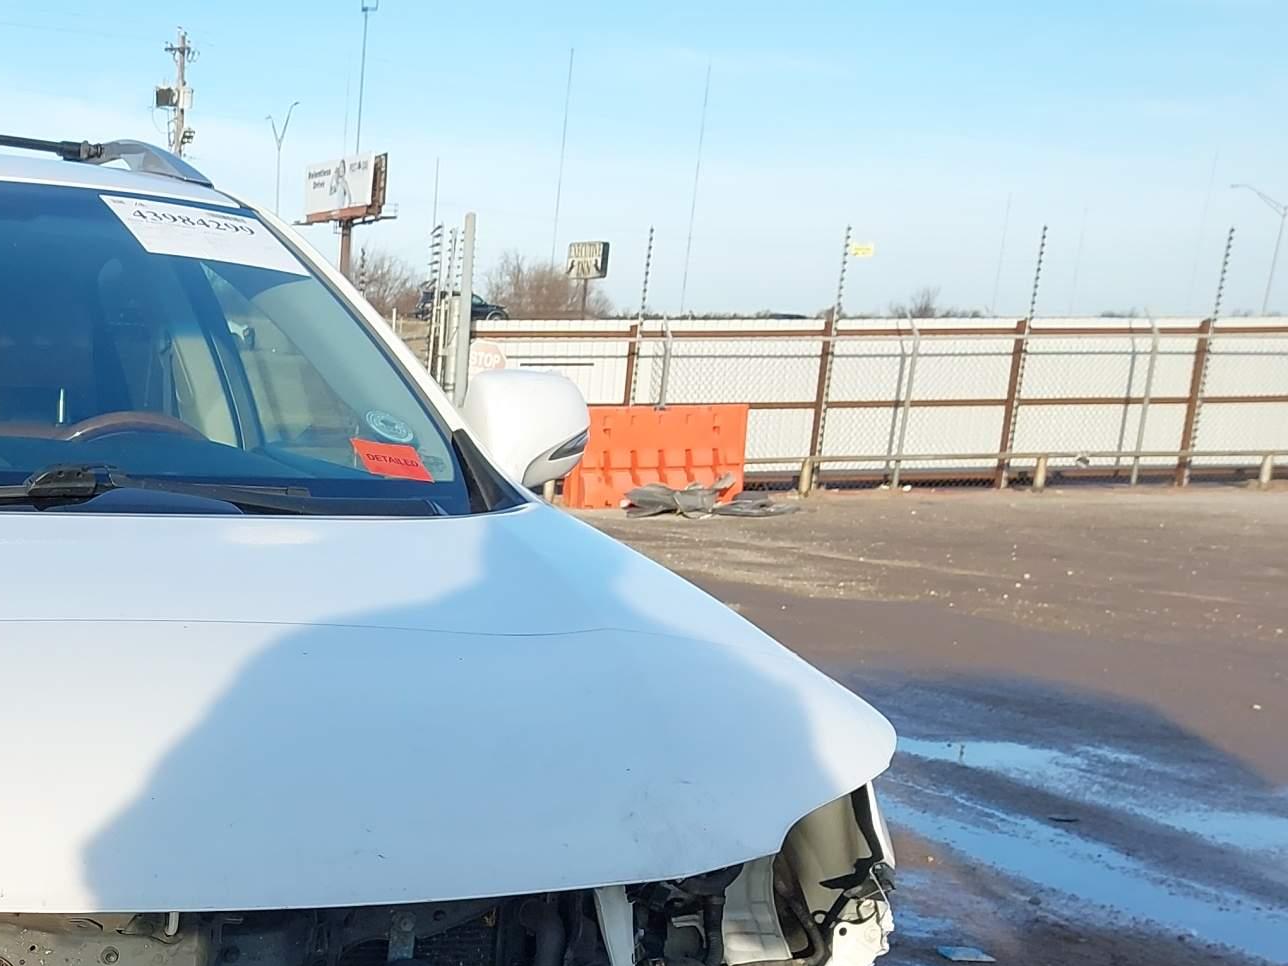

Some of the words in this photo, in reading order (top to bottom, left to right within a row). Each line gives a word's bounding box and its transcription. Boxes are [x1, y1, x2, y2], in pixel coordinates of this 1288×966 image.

[132, 208, 256, 236] 43984299
[470, 351, 502, 368] STOP
[365, 452, 420, 468] DETAILED
